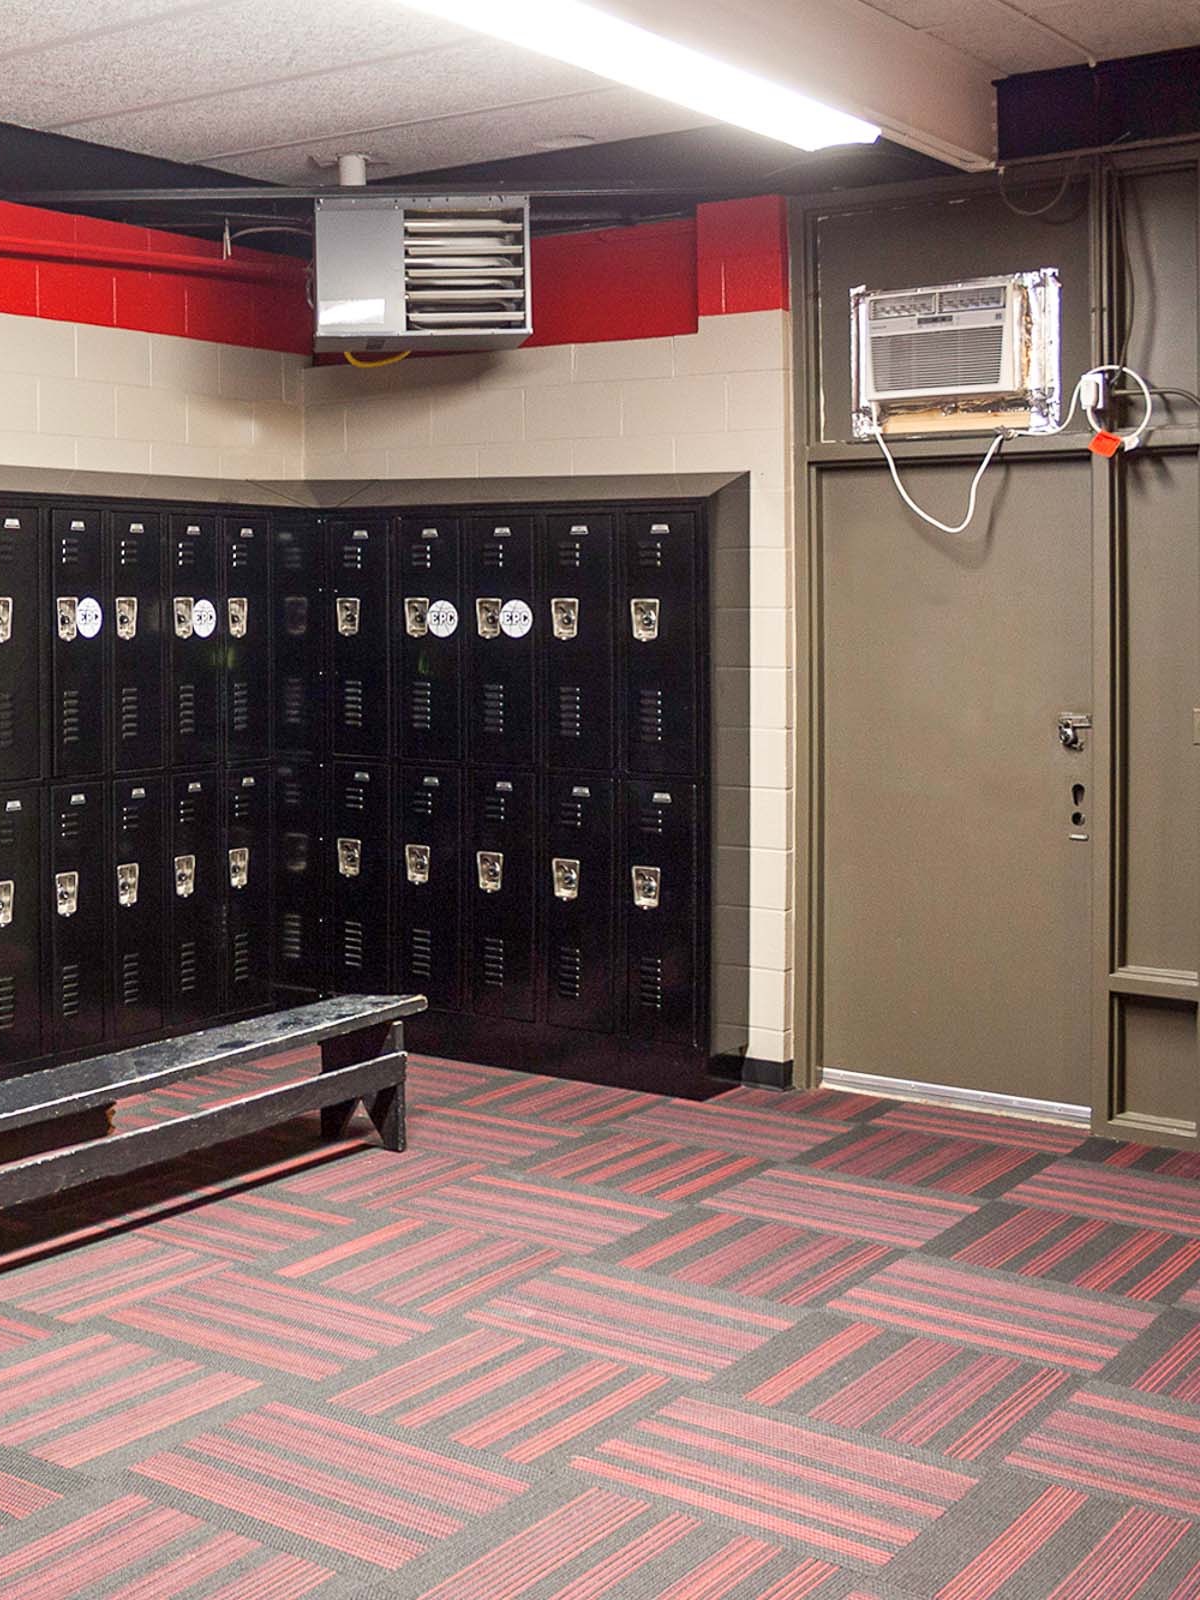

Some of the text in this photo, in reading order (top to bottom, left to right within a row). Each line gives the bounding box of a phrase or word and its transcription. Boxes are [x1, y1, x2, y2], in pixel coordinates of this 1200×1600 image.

[77, 608, 99, 625] EPC
[194, 608, 214, 625] EPC
[428, 609, 456, 626] EPC
[501, 609, 531, 626] EPC
